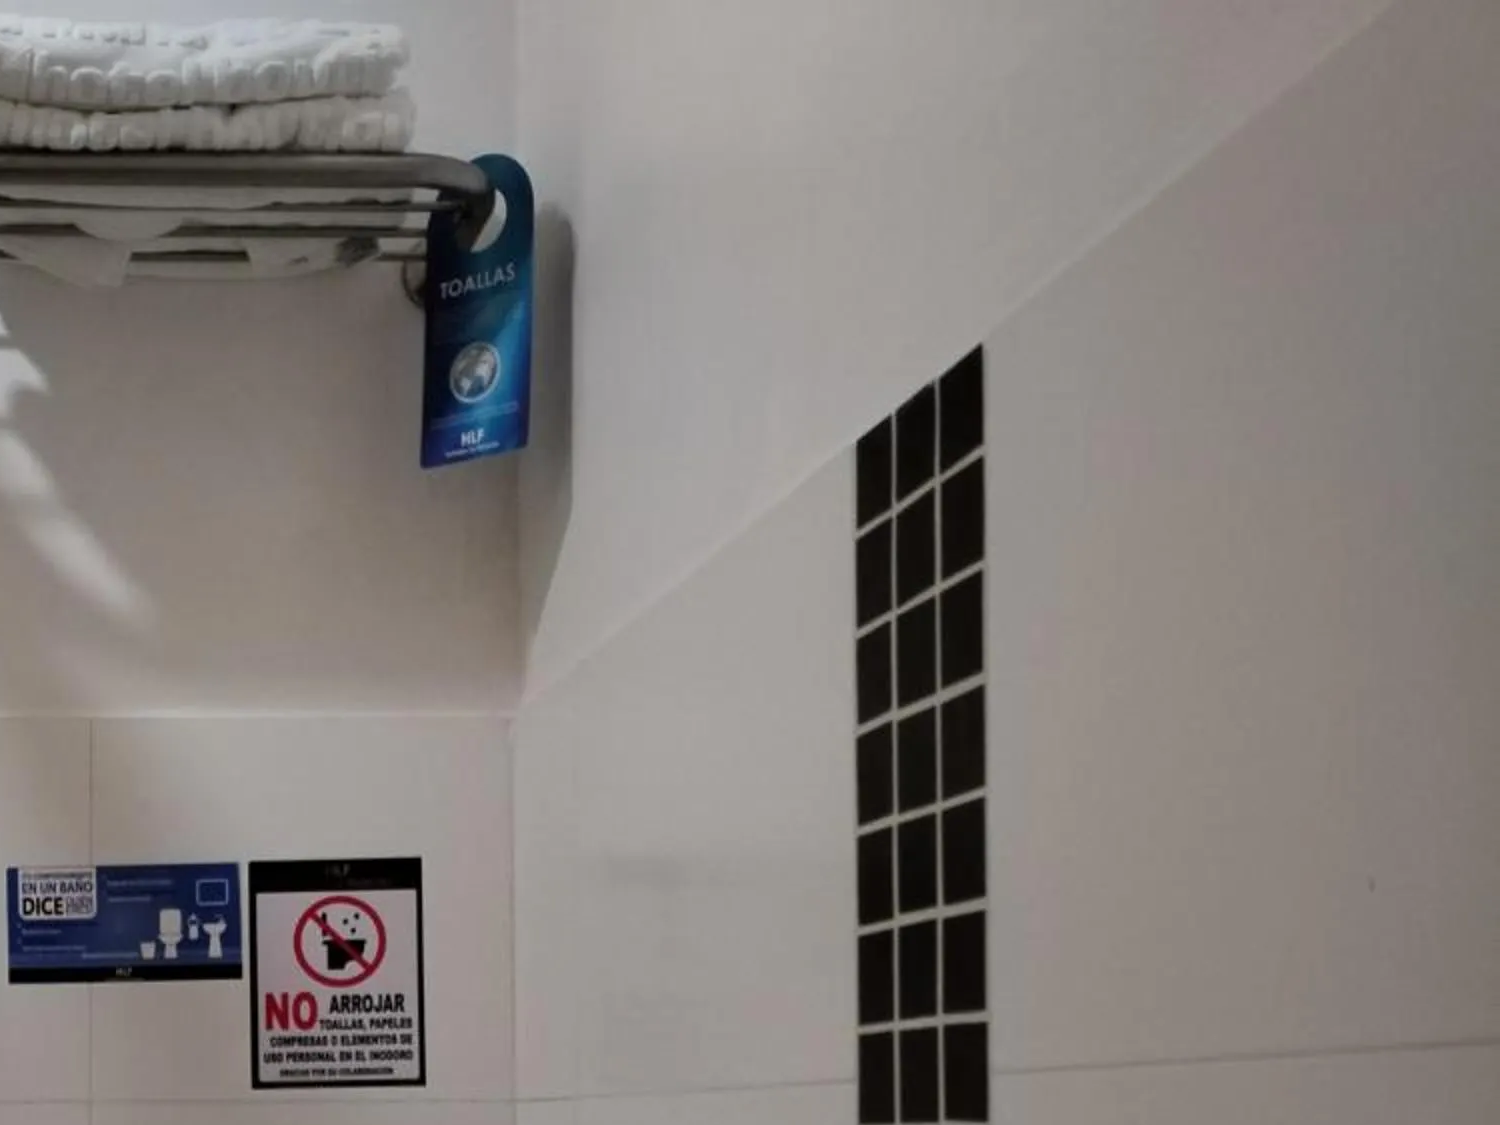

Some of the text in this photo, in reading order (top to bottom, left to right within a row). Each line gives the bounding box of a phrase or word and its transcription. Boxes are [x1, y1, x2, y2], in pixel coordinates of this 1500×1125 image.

[439, 262, 516, 299] TOALLAS
[460, 427, 485, 448] HLF
[40, 881, 57, 893] UN
[22, 896, 65, 916] DICE
[265, 991, 318, 1031] NO
[329, 993, 405, 1014] ARROJAR
[369, 1017, 413, 1029] PAPELES
[340, 1034, 398, 1046] ELEMENTOS
[400, 1033, 413, 1045] DE
[263, 1049, 414, 1064] USO PERSONAL EN EL INODORO
